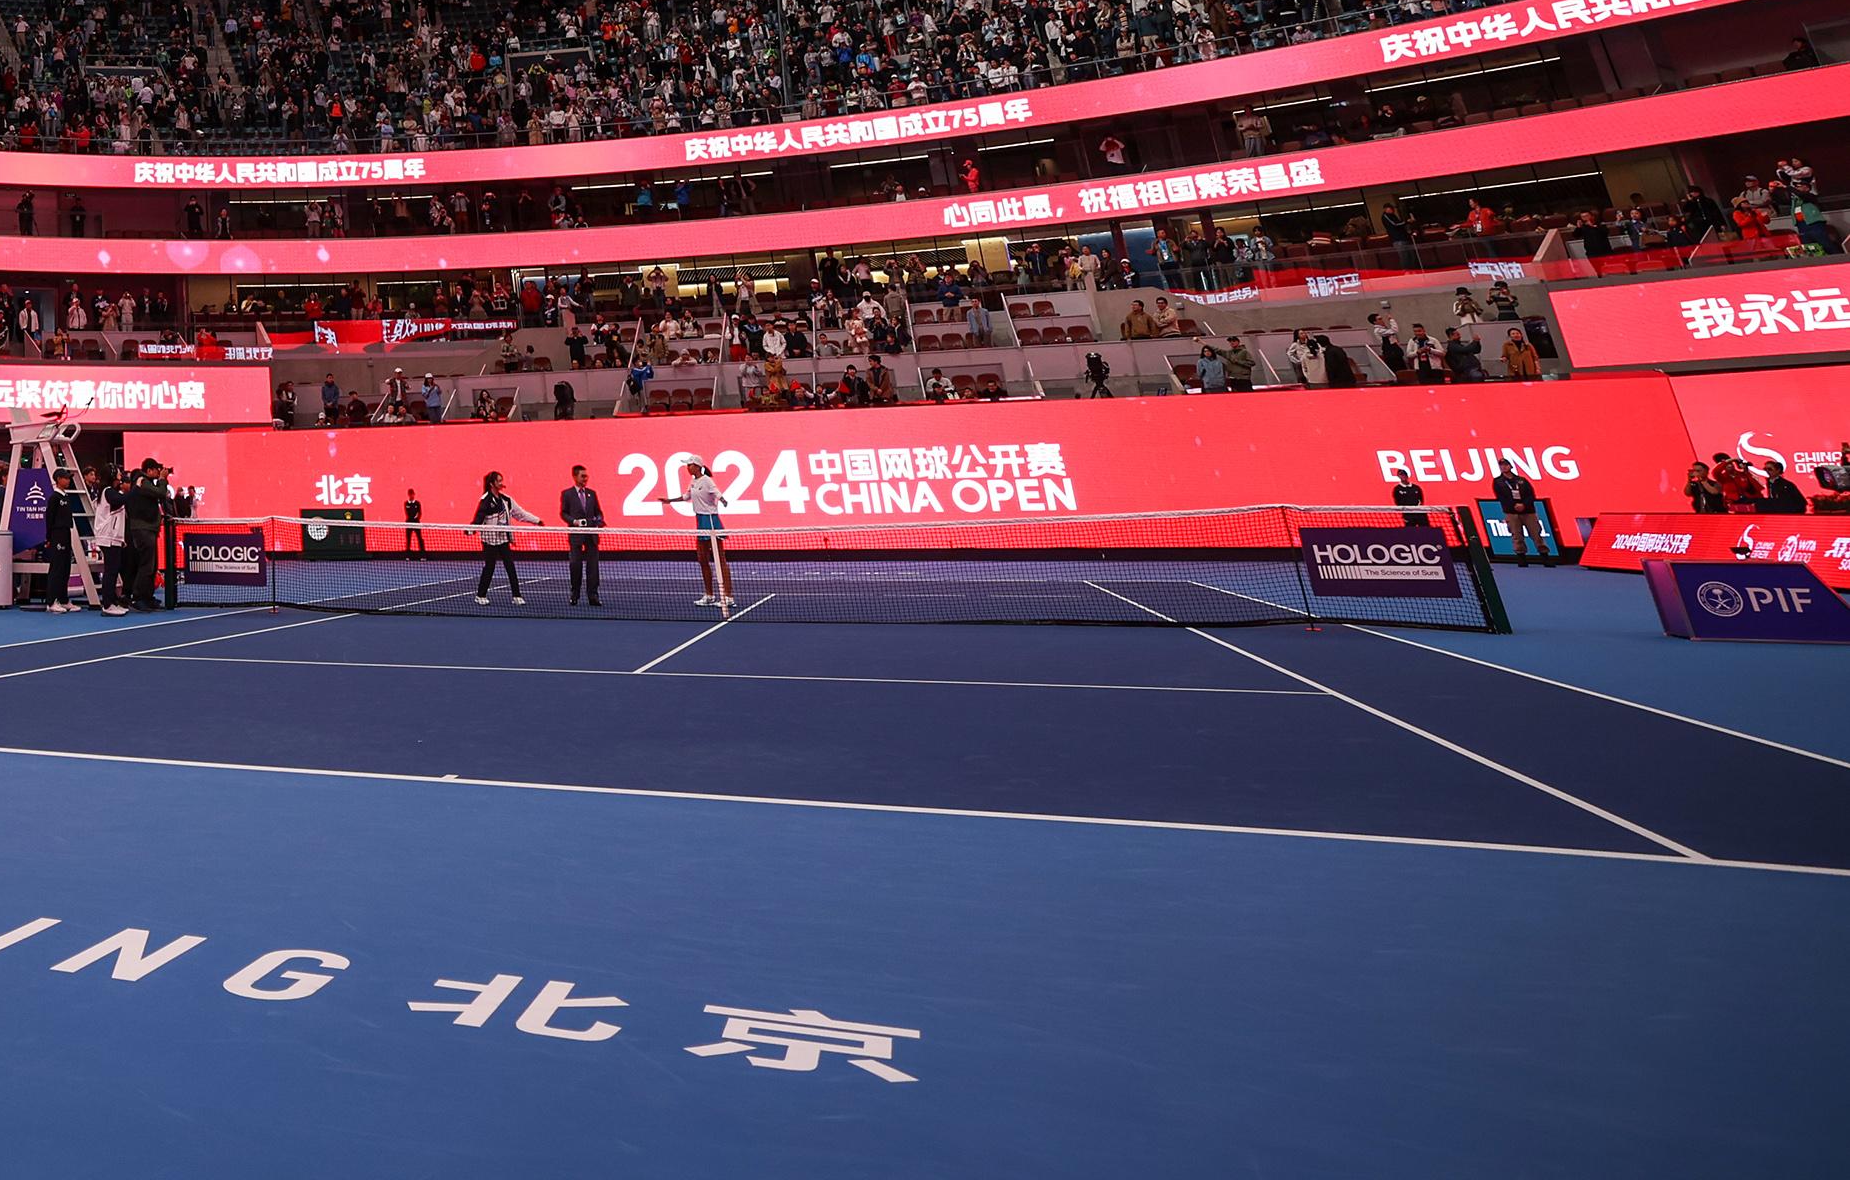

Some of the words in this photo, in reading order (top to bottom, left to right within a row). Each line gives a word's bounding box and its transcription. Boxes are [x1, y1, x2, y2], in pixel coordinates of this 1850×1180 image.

[685, 99, 1032, 162] 庆祝中华人民共和国成立75周年
[134, 158, 425, 186] 庆祝中华人民共和国成立75周年
[1681, 288, 1850, 339] 我永远
[809, 443, 1067, 481] 中国网球公开赛
[1377, 446, 1580, 483] BEIJING
[315, 473, 373, 505] 北京
[618, 450, 809, 516] 2024
[816, 482, 942, 516] CHINA
[951, 477, 1077, 513] OPEN
[1381, 569, 1412, 577] Science
[1421, 569, 1440, 577] Sure
[1745, 587, 1813, 613] PIF
[407, 974, 921, 1082] 北京
